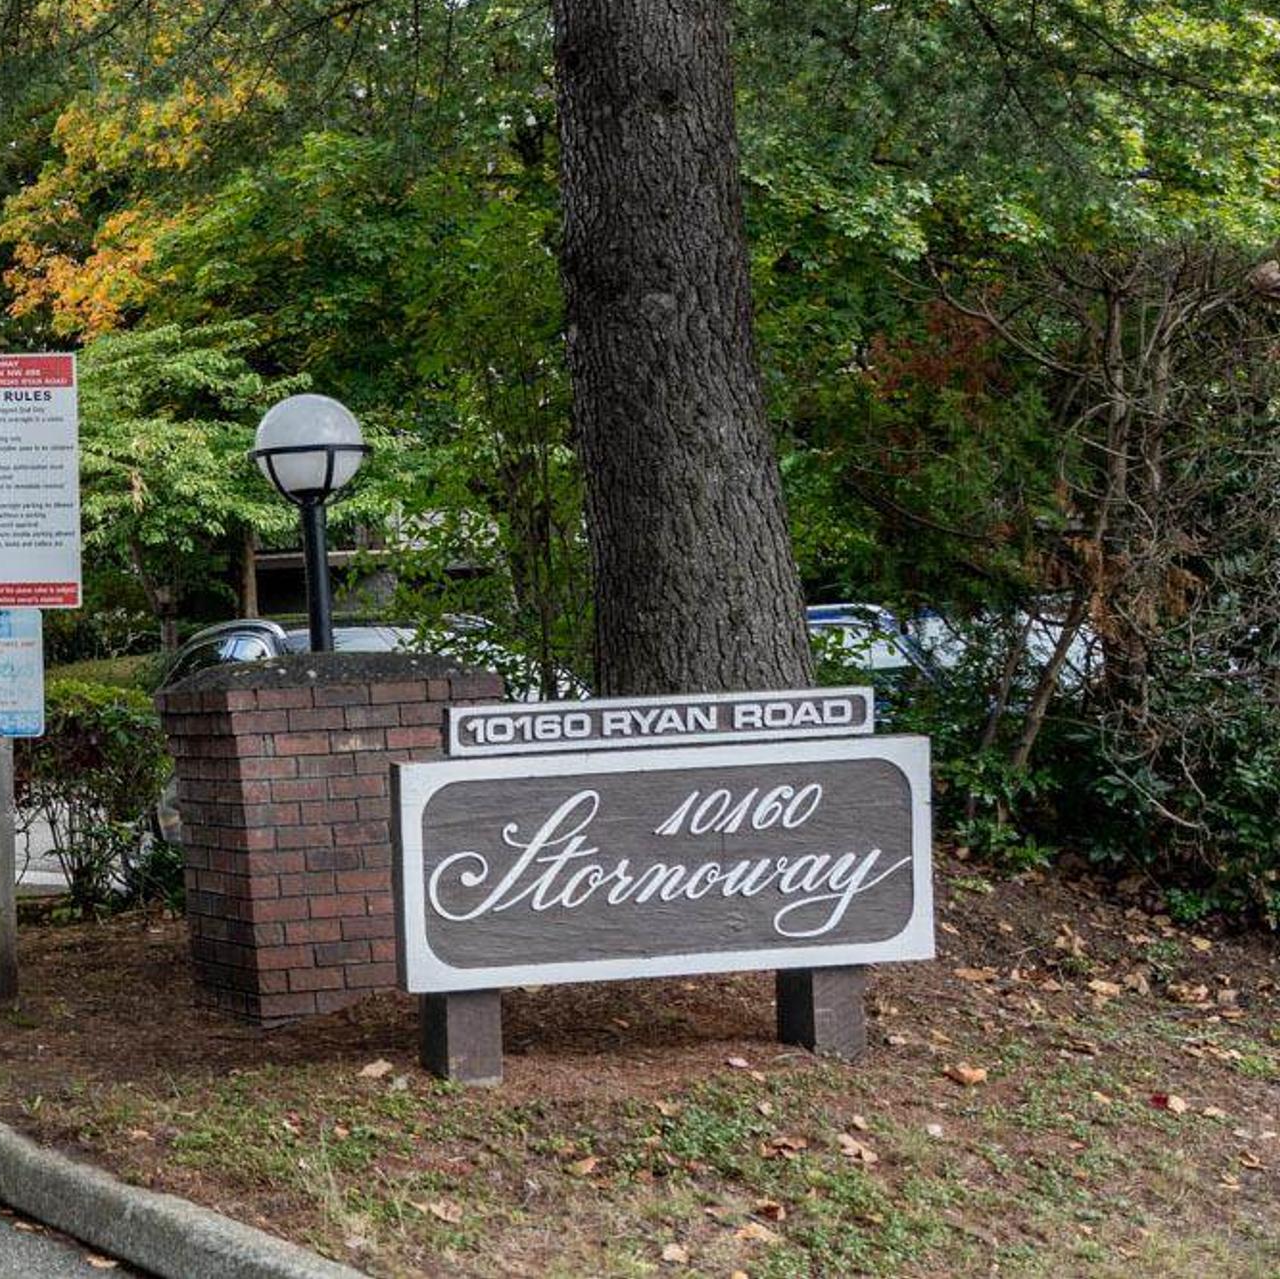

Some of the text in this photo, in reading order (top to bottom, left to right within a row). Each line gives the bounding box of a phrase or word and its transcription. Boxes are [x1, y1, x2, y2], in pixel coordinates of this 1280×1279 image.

[2, 389, 53, 402] RULES
[464, 697, 854, 746] 10160 RYAN ROAD
[653, 782, 825, 836] 10160
[427, 788, 914, 939] Stornoway
